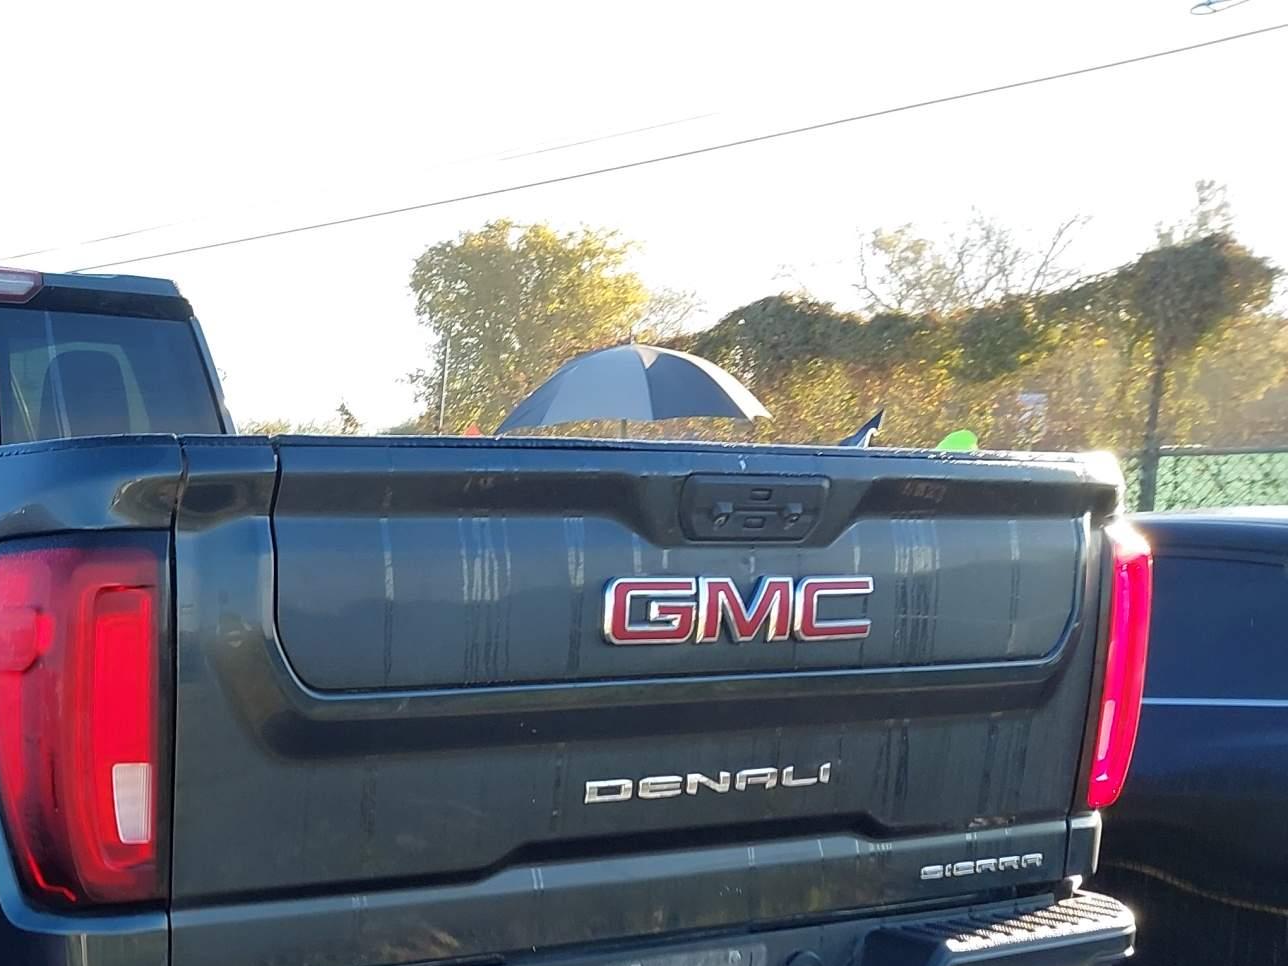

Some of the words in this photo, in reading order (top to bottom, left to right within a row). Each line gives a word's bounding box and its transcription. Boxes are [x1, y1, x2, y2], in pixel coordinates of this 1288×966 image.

[603, 575, 874, 646] GMC
[583, 761, 832, 805] DENALI
[920, 853, 1044, 880] SIERRA
